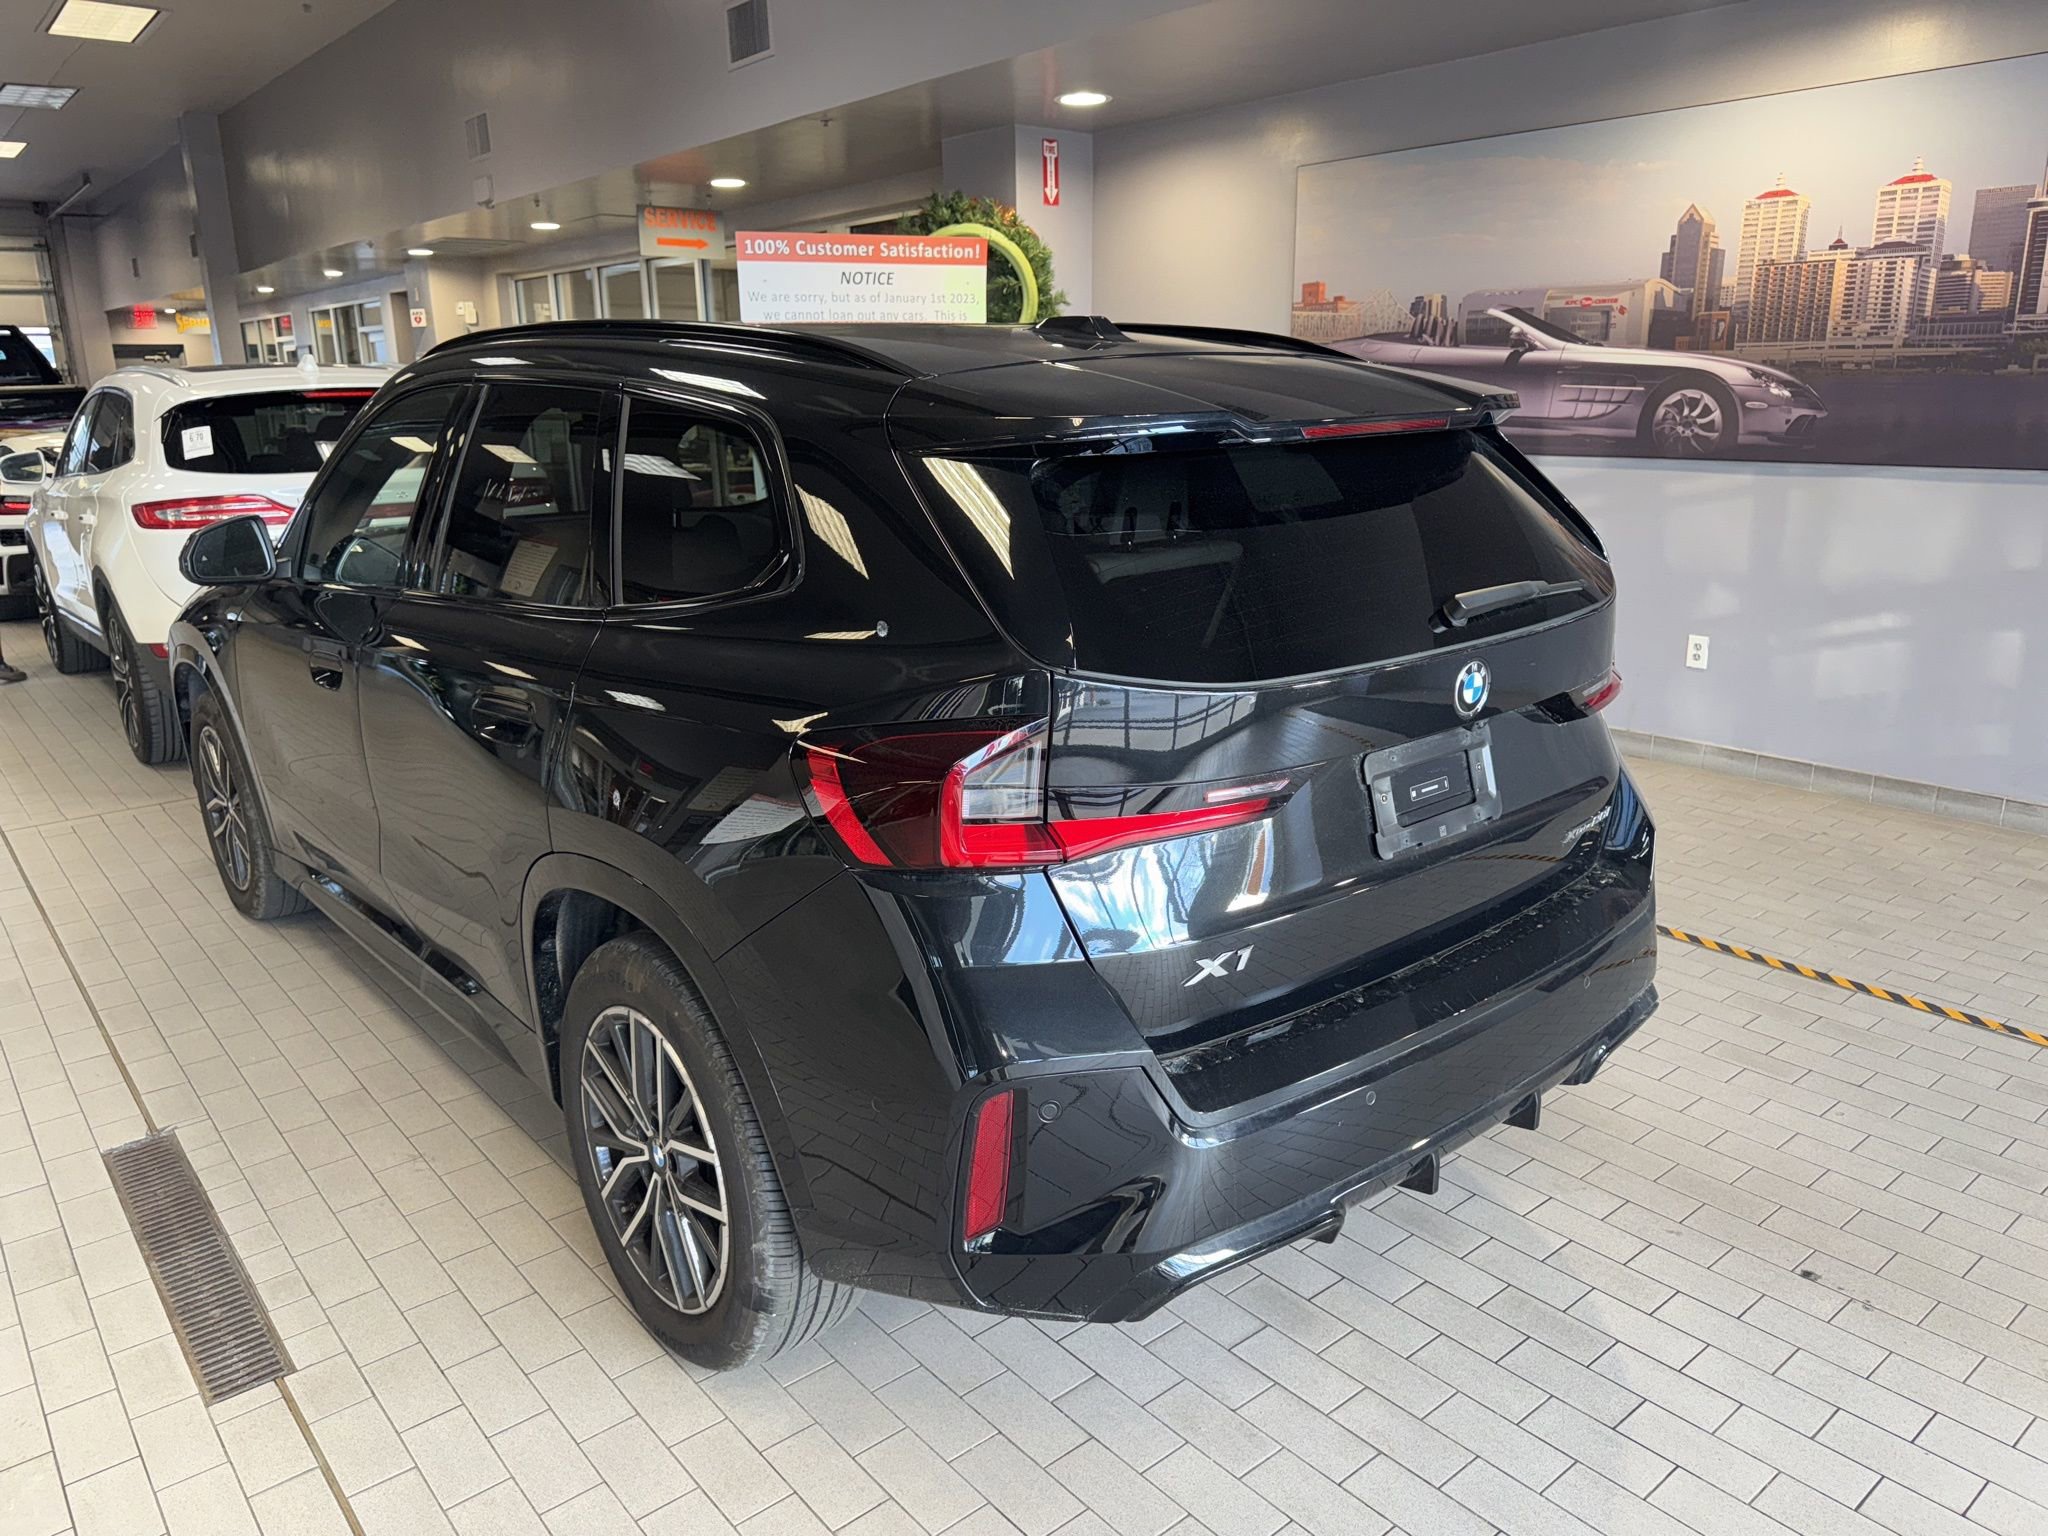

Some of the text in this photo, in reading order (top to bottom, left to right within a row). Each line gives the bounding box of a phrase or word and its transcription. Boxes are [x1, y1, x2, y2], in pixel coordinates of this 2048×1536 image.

[643, 207, 717, 232] SERVICE
[744, 239, 980, 259] 100% Customer Satisfaction!
[840, 271, 895, 285] NOTICE
[748, 290, 980, 305] We are sorry, but as of January 1st 2023,
[762, 309, 967, 322] we cannot loan out any cars. This is
[1183, 944, 1255, 988] X1
